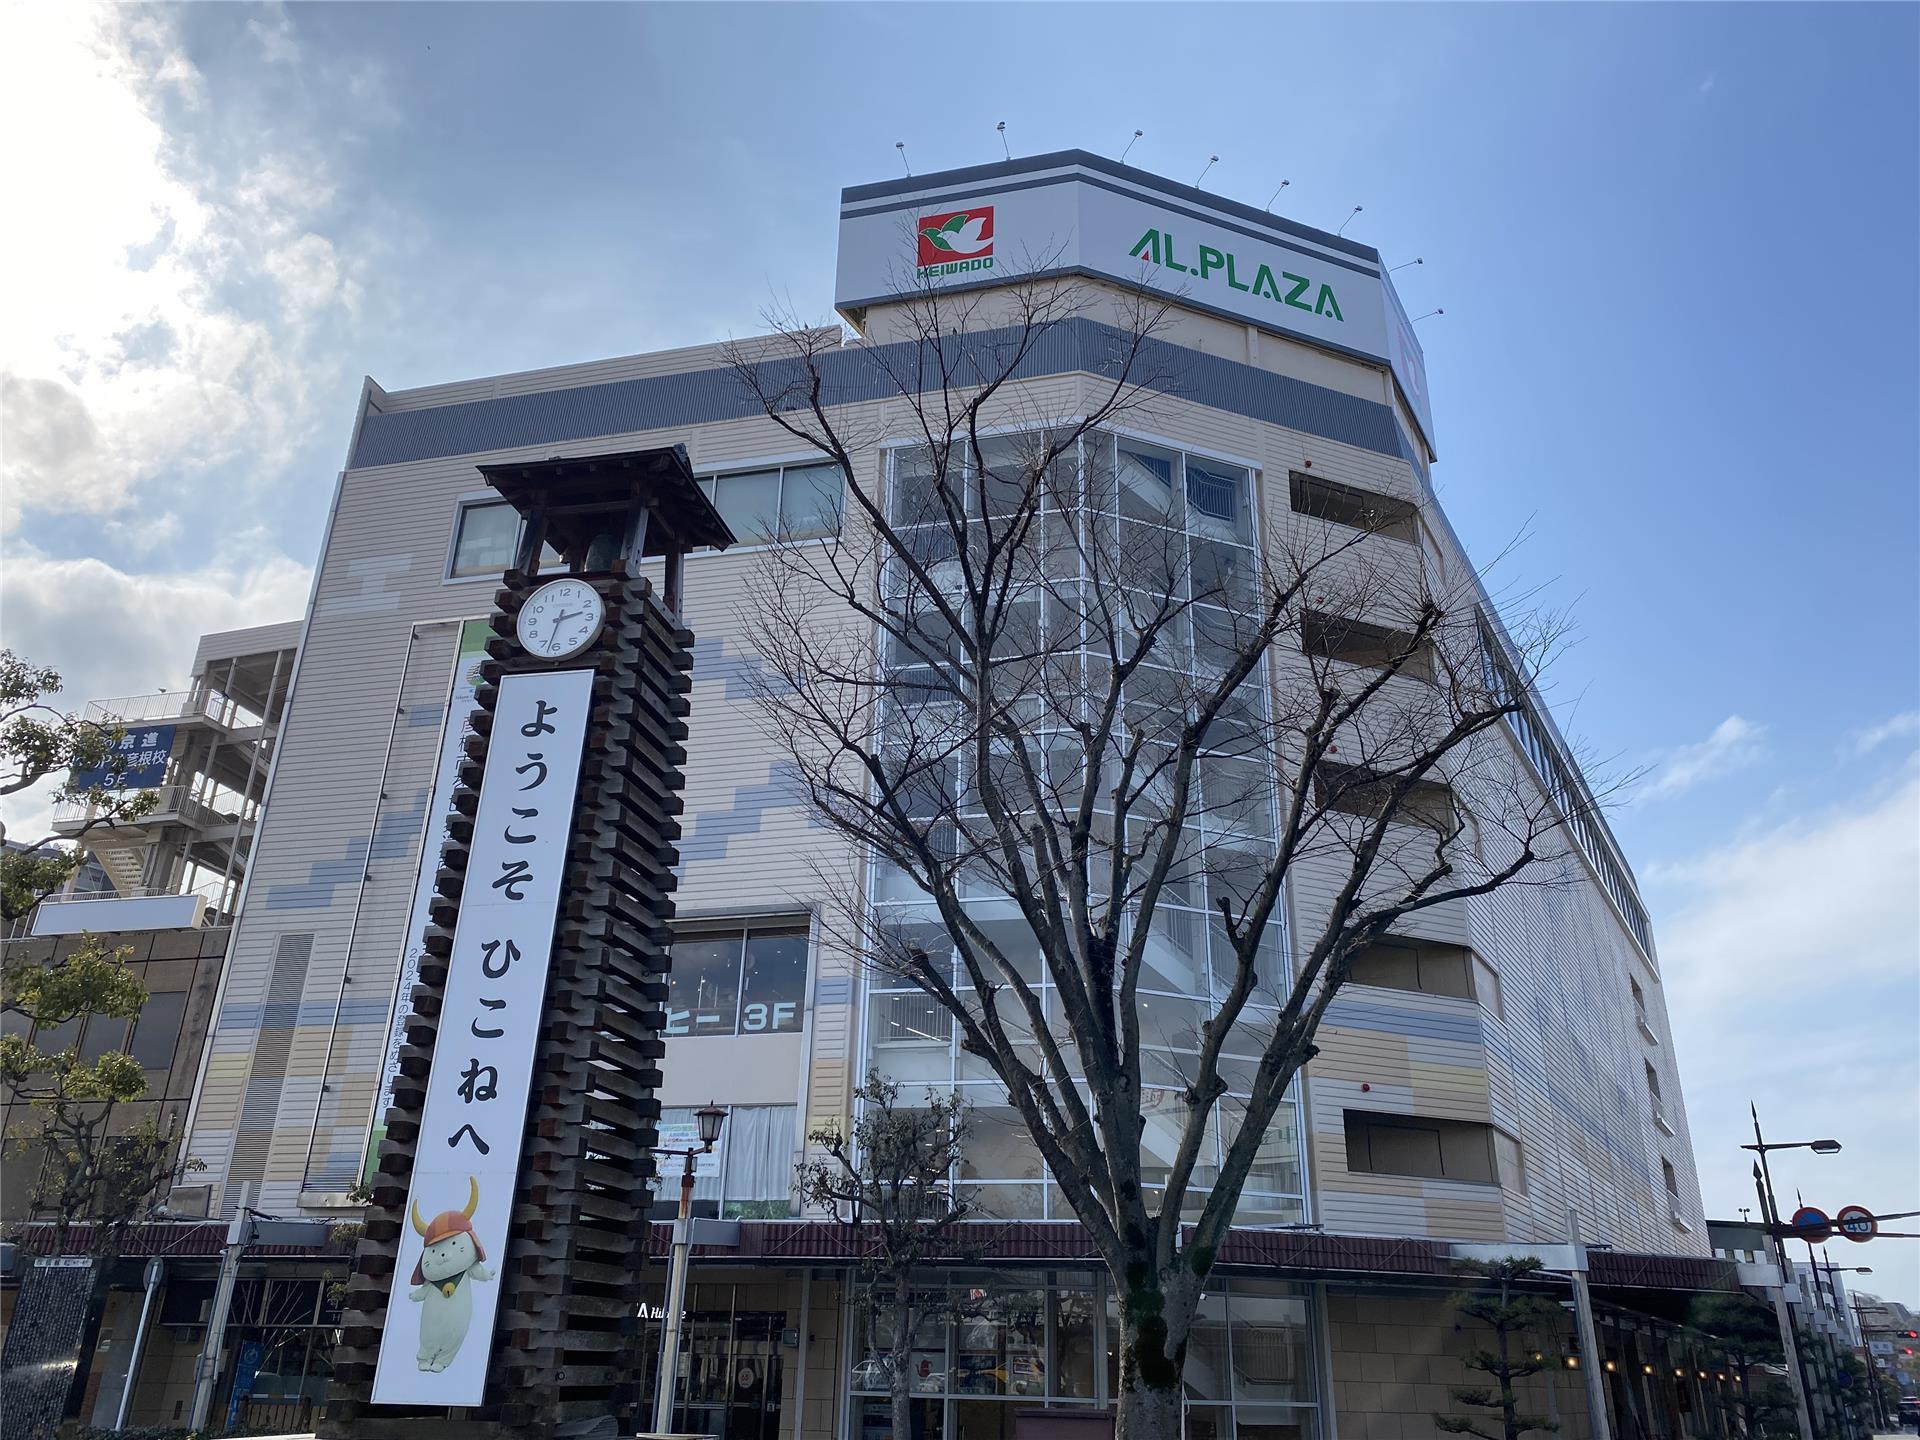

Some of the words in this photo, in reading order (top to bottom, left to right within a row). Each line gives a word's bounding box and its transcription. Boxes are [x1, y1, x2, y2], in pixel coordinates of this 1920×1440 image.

[917, 257, 993, 279] HEIWADO
[1128, 228, 1344, 322] AL.PLAZA
[560, 588, 571, 597] 12
[577, 590, 581, 599] 1
[544, 595, 555, 603] 11
[583, 600, 592, 608] 2
[533, 606, 544, 614] 10
[585, 613, 594, 621] 3
[528, 618, 537, 626] 9
[579, 626, 589, 634] 4
[529, 631, 538, 639] 8
[539, 640, 548, 648] 7
[568, 637, 578, 645] 5
[551, 643, 561, 651] 6
[119, 732, 159, 749] 京進
[492, 700, 558, 901] ようこそ
[743, 1002, 796, 1030] 3F
[448, 939, 521, 1155] ひこねへ
